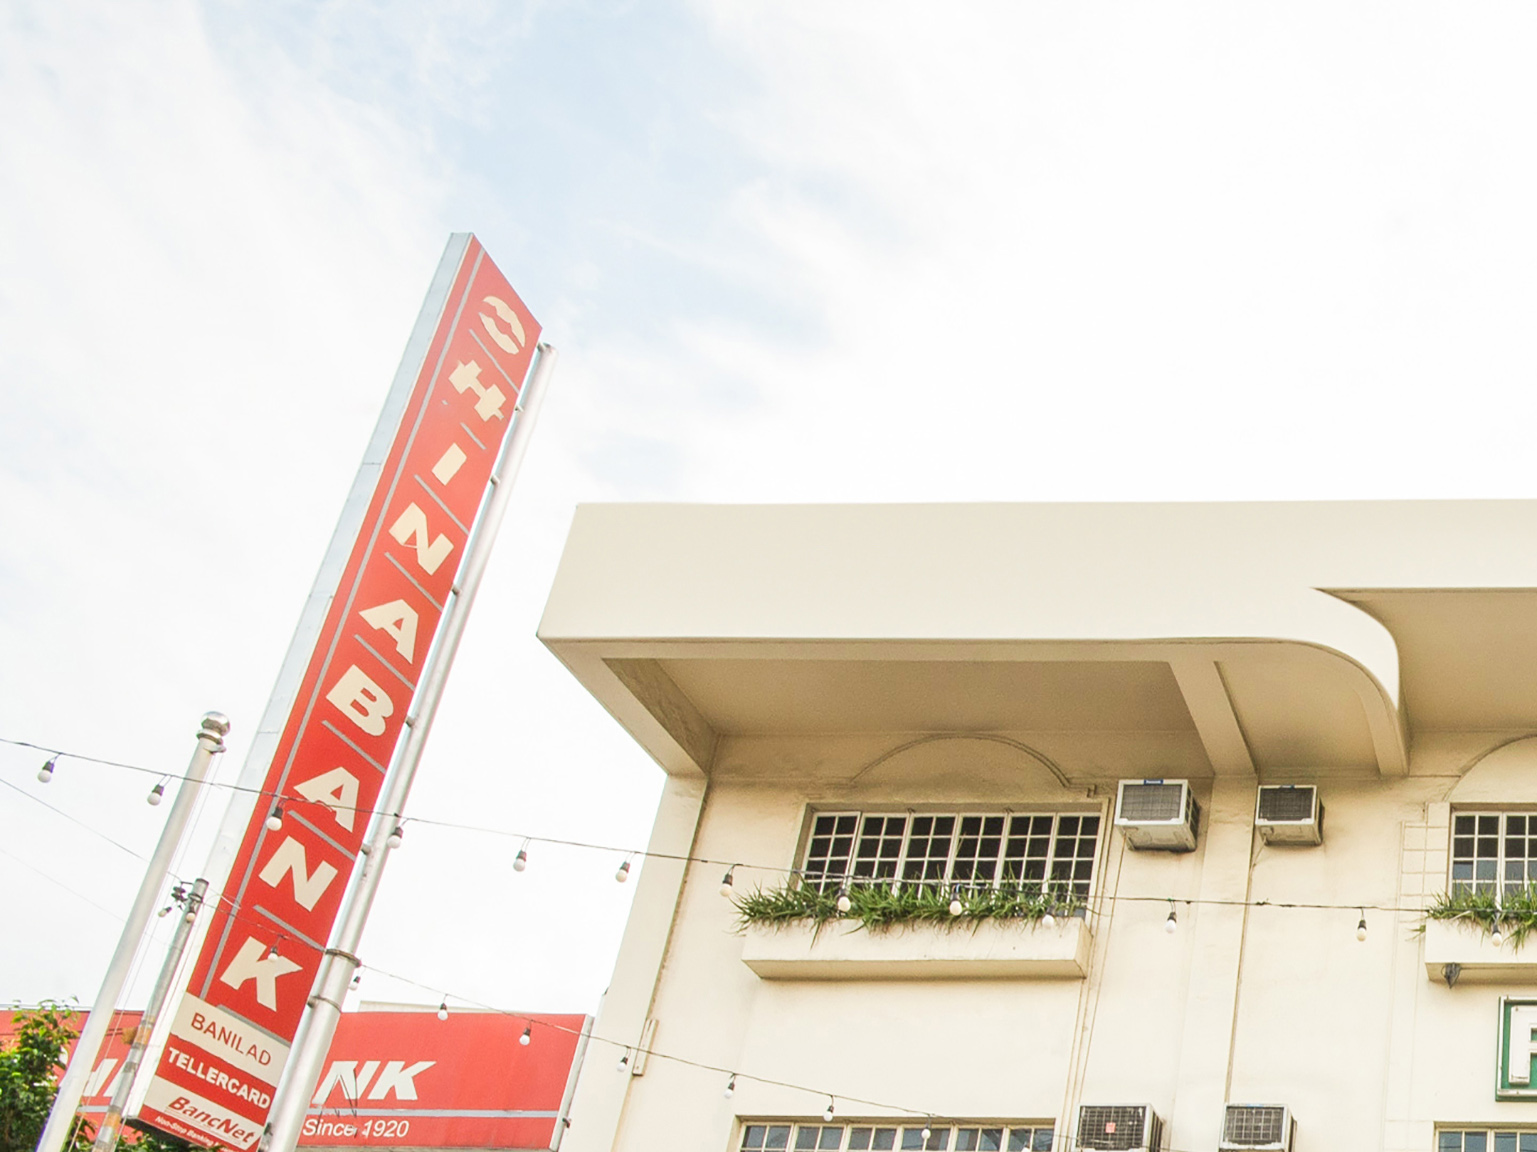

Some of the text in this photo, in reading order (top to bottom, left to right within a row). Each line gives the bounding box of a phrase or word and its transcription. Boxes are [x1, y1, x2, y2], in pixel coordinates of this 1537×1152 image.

[191, 1012, 271, 1066] BANILAD
[168, 1047, 271, 1109] TELLERCARD
[168, 1096, 255, 1143] BancNet
[302, 1119, 409, 1138] Since 1920
